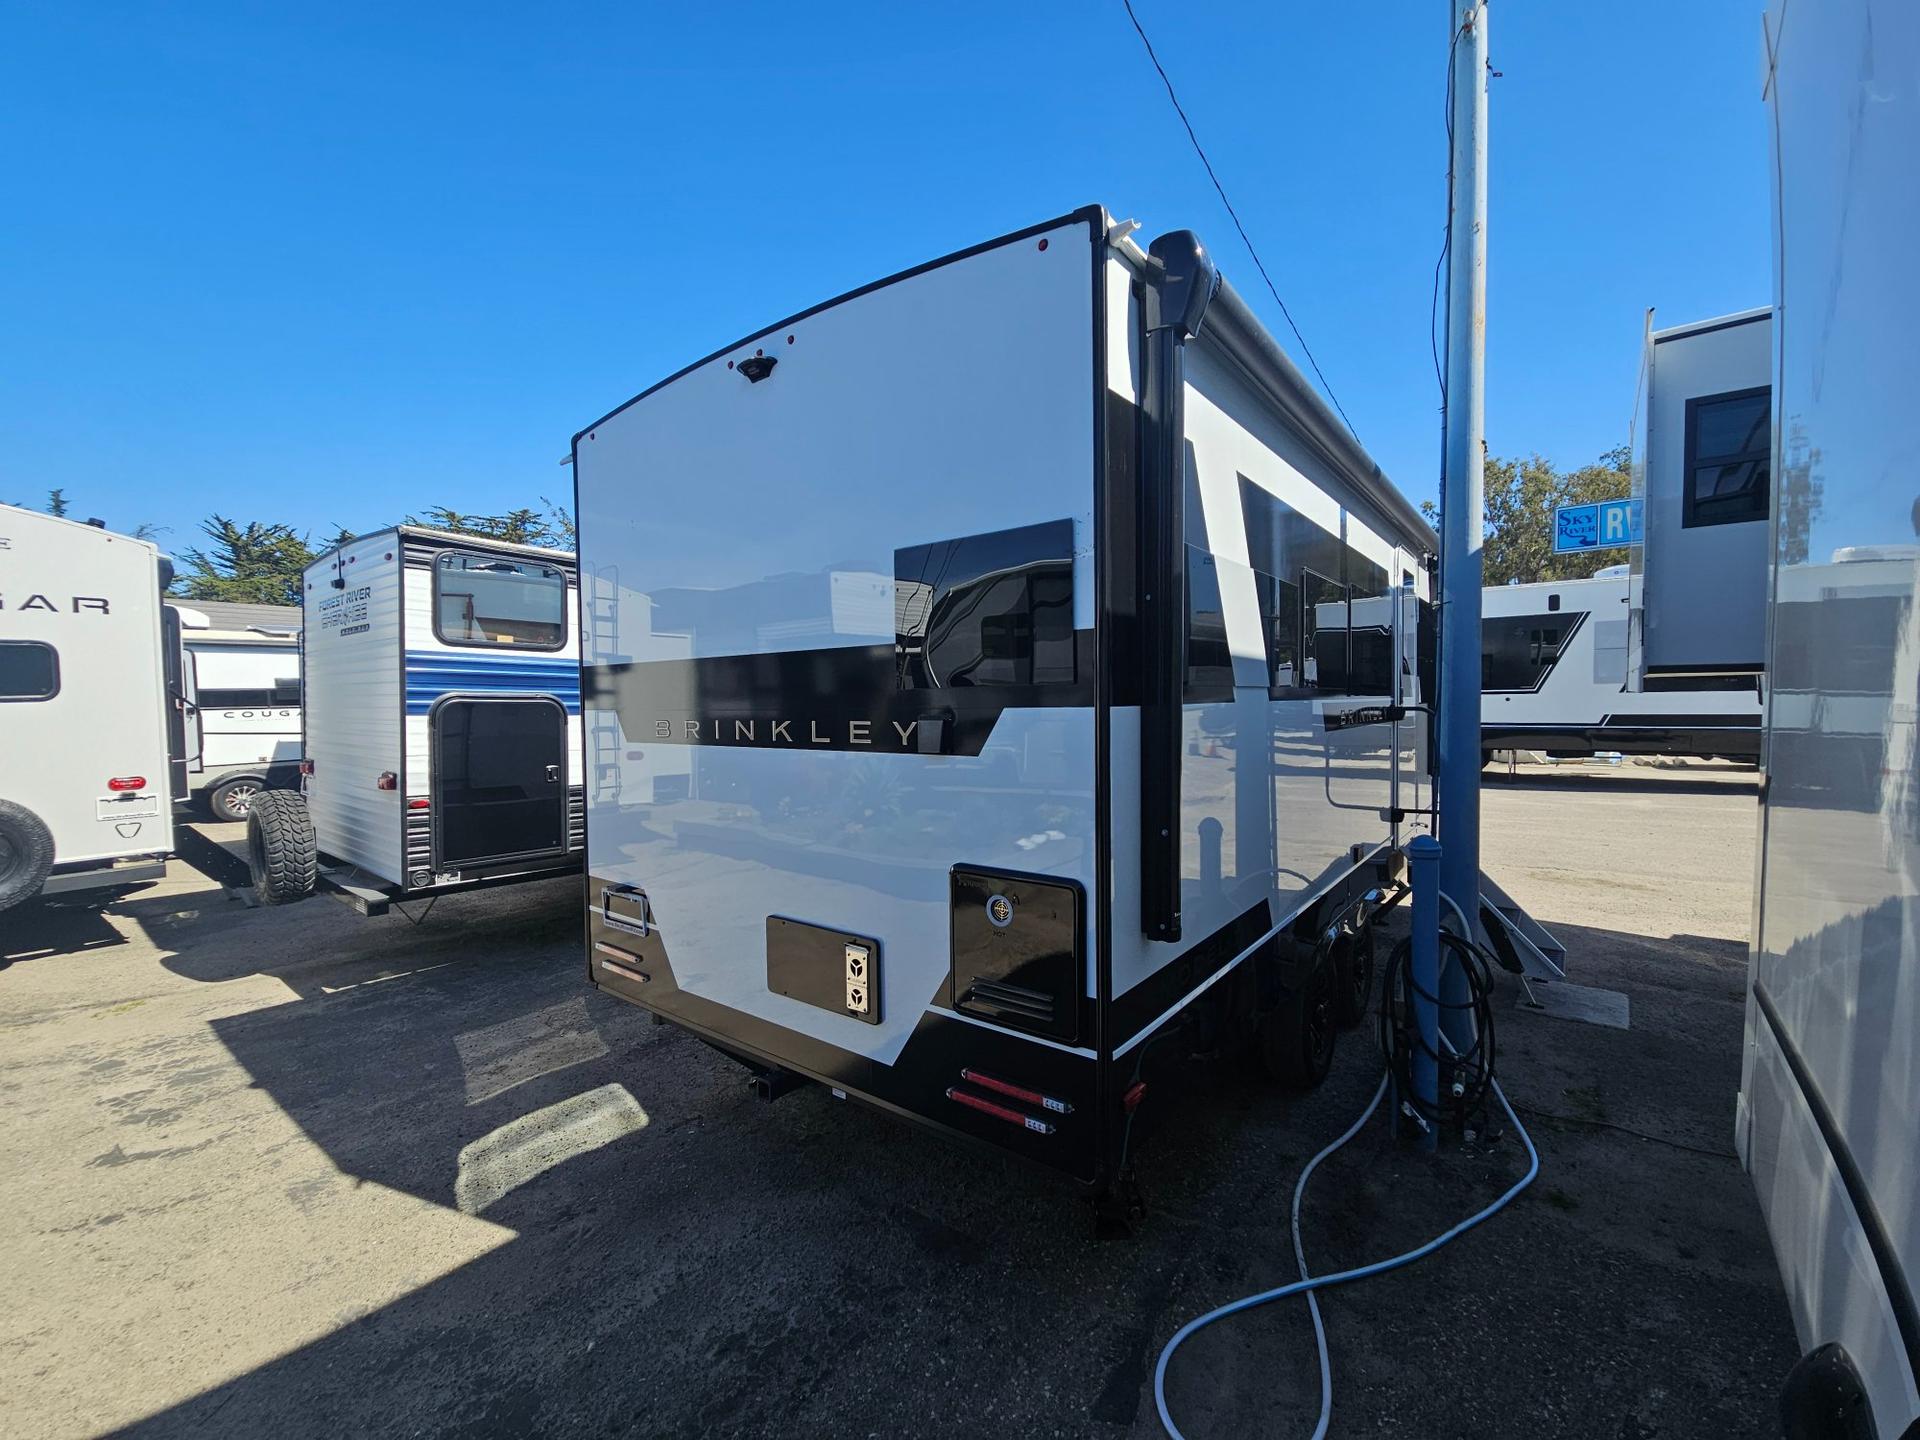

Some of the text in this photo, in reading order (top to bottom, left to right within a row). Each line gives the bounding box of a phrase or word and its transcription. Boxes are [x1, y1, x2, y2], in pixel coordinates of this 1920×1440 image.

[1560, 525, 1596, 536] RIVER
[0, 593, 110, 615] AR
[319, 587, 371, 612] FOREST RIVER
[656, 720, 918, 746] BRINKLEY
